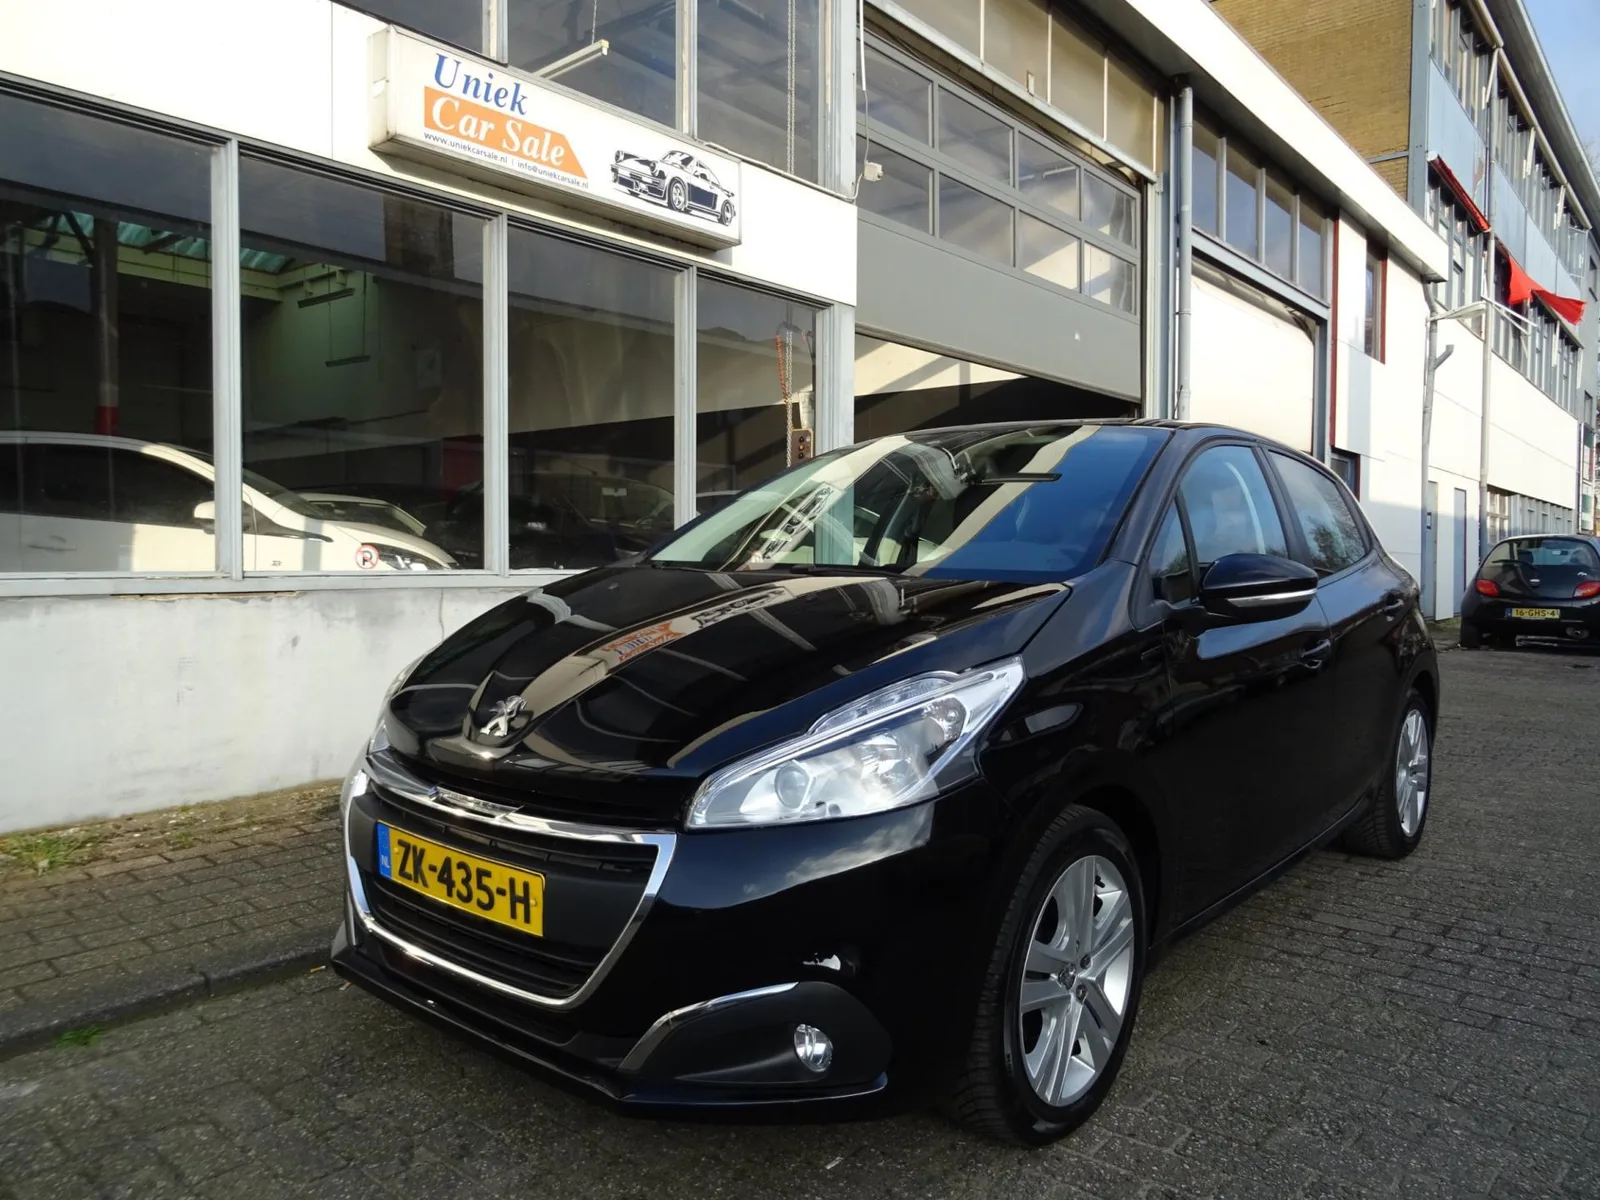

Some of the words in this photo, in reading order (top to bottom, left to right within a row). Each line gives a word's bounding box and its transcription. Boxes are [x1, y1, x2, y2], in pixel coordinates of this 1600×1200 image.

[434, 53, 528, 116] Uniek
[424, 132, 508, 163] www.uniekcarsale.nl
[517, 160, 589, 189] info@uniekcarsale.nl
[432, 96, 496, 142] Car
[502, 119, 566, 166] Sale
[380, 854, 391, 869] NL
[397, 838, 532, 925] ZK-435-H
